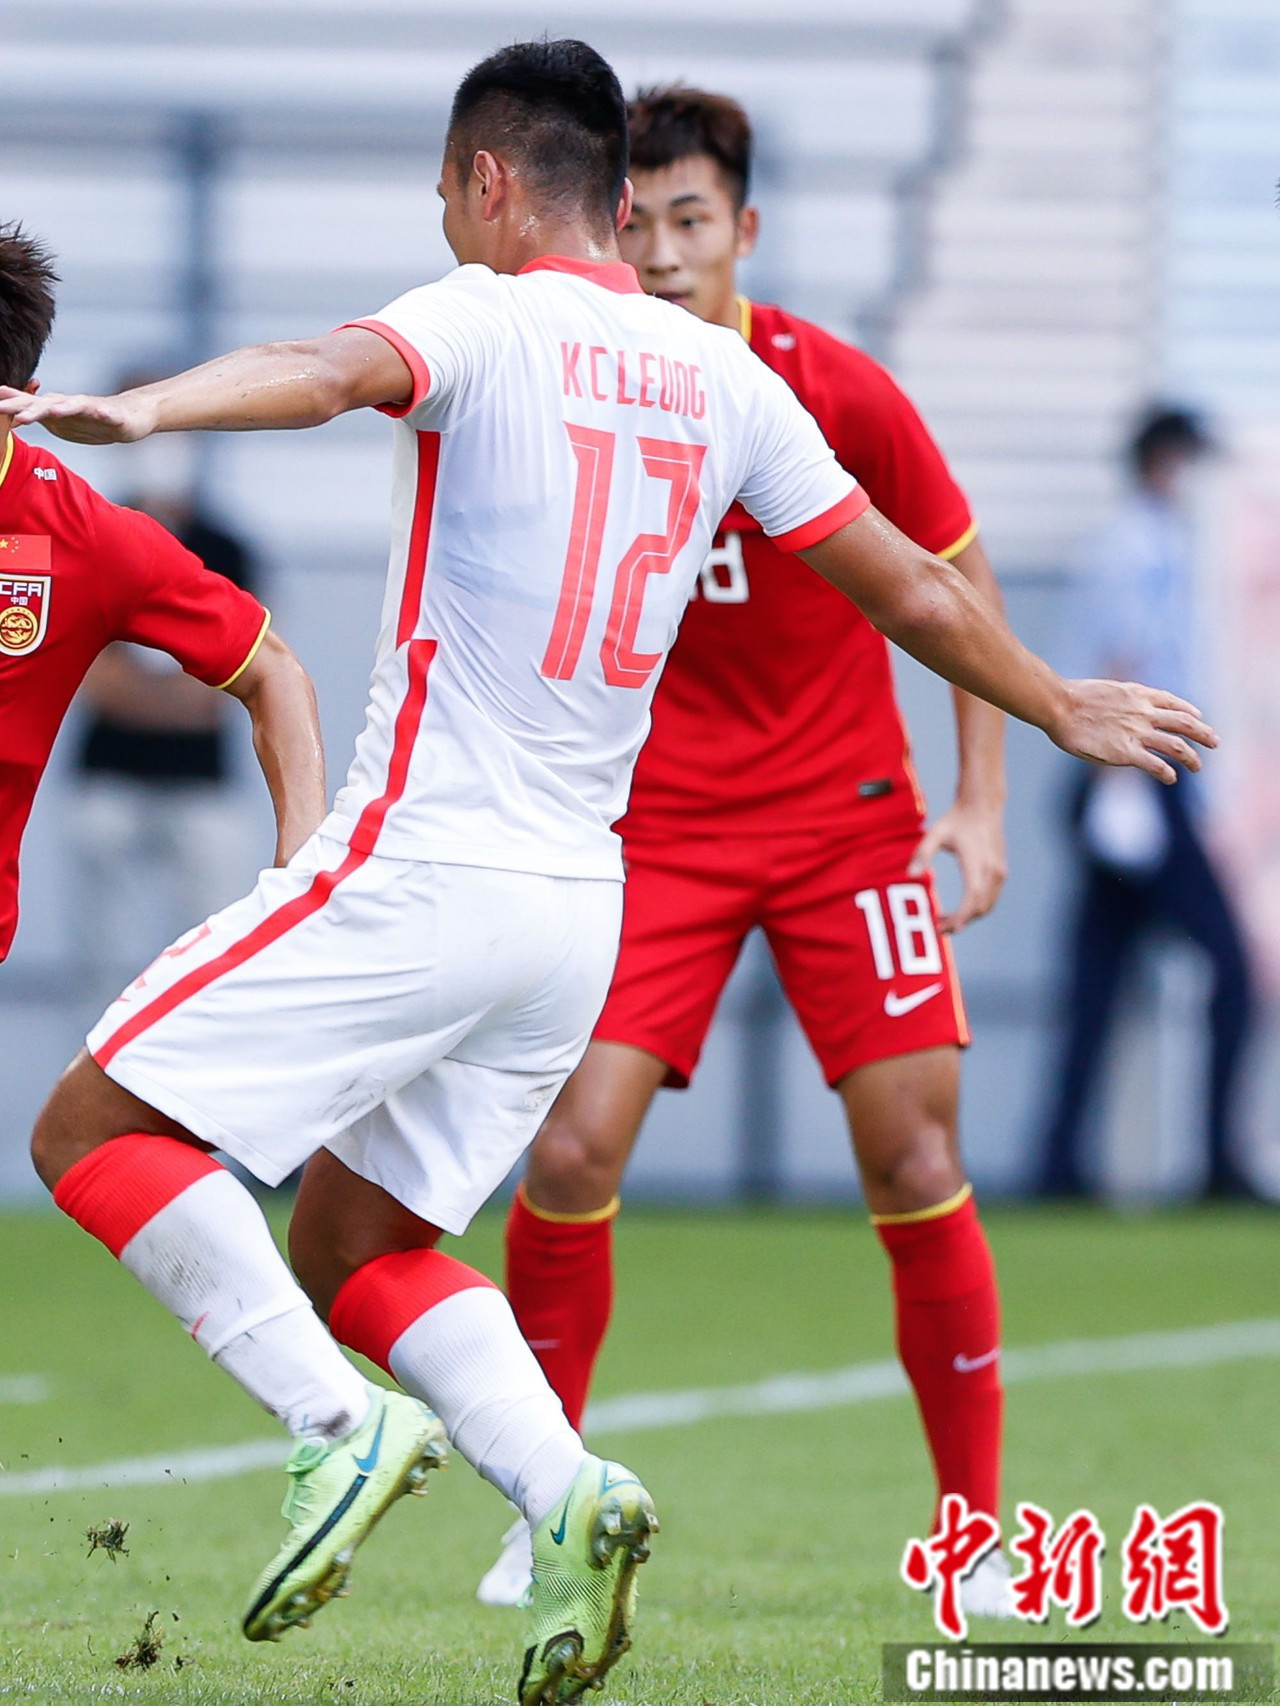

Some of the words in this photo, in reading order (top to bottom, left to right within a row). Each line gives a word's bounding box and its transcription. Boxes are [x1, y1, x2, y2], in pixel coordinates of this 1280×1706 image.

[560, 341, 582, 398] K
[588, 346, 609, 402] C
[616, 350, 706, 421] LEUNG
[539, 420, 708, 690] 12
[688, 531, 750, 604] 8
[854, 882, 944, 981] 18
